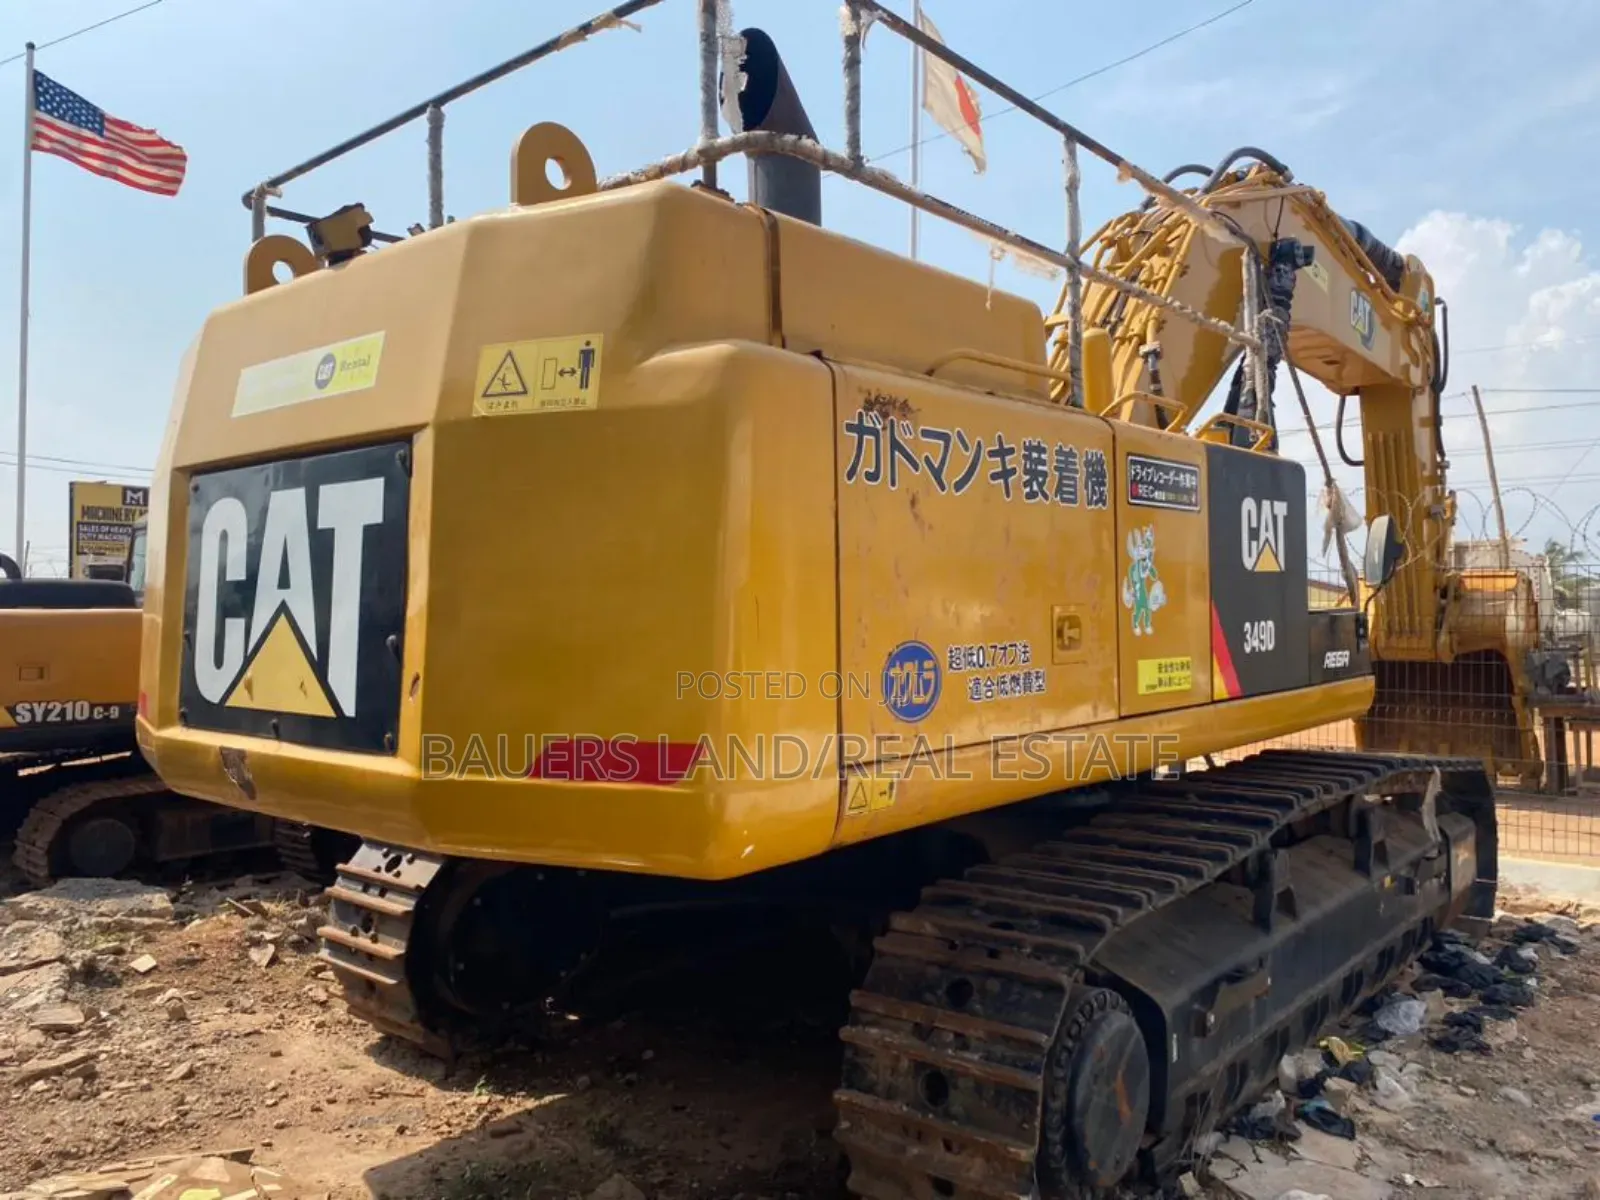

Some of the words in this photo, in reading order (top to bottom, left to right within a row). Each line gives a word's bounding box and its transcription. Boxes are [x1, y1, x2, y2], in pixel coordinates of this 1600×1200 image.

[1351, 290, 1372, 335] CAT
[845, 410, 1107, 508] ガドマンキ装着機
[81, 505, 137, 522] MACHINERY
[1241, 497, 1288, 572] CAT
[194, 477, 385, 718] CAT
[1243, 620, 1276, 654] 349D
[15, 701, 90, 724] SY210
